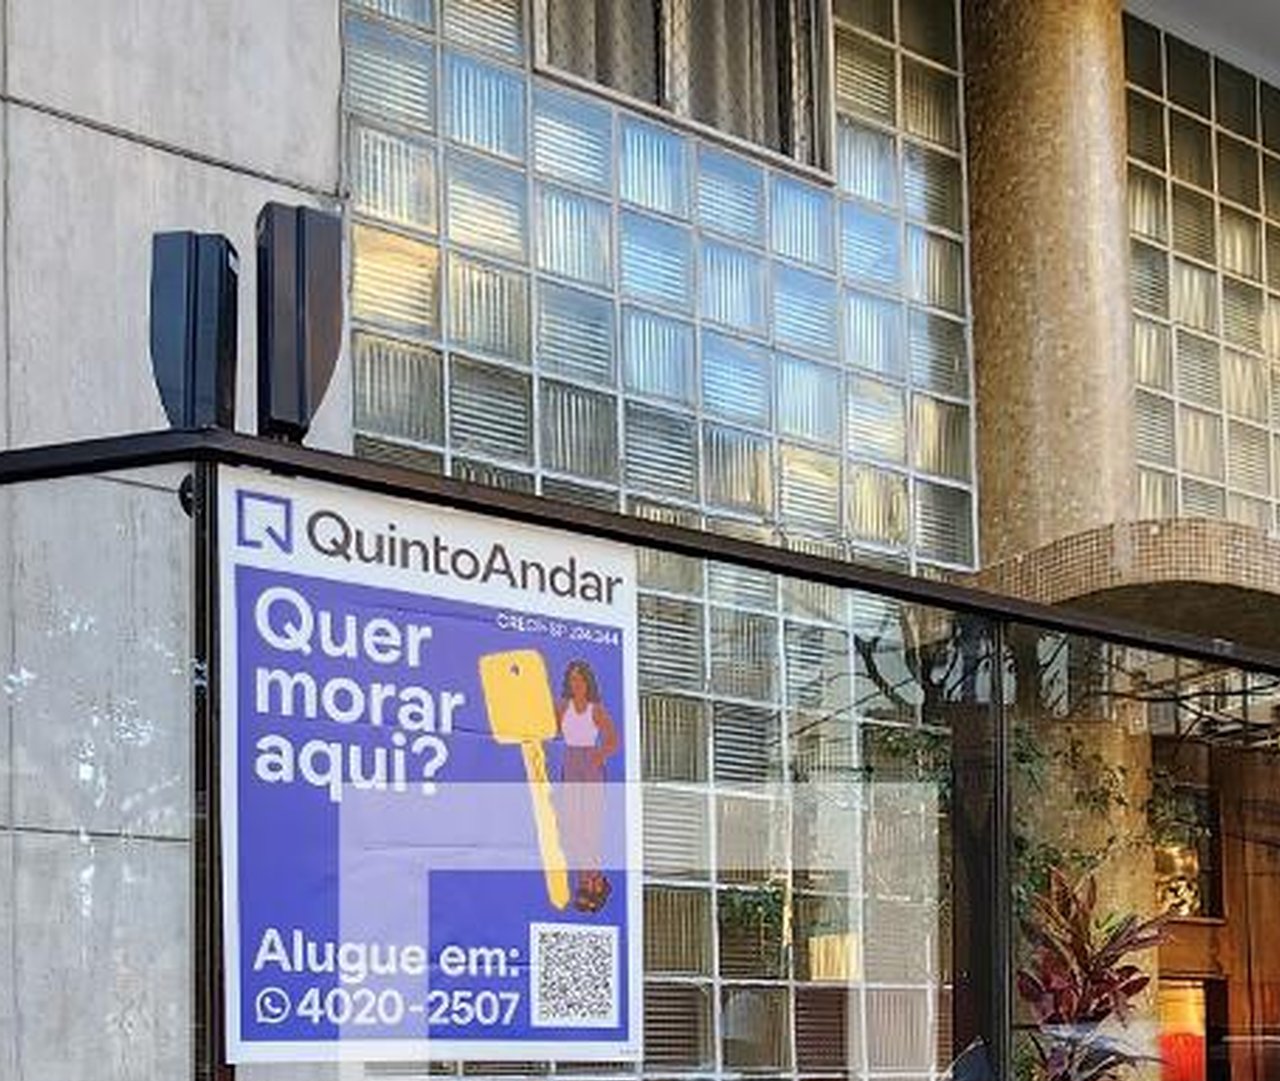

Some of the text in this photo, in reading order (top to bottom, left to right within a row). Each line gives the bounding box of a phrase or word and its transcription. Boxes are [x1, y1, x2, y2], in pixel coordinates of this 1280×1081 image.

[306, 510, 624, 605] QuintoAndar
[254, 586, 433, 668] Quer
[254, 667, 466, 734] morar
[254, 732, 449, 803] aqui?
[253, 927, 521, 984] Alugue em:
[296, 988, 521, 1026] 4020-2507
